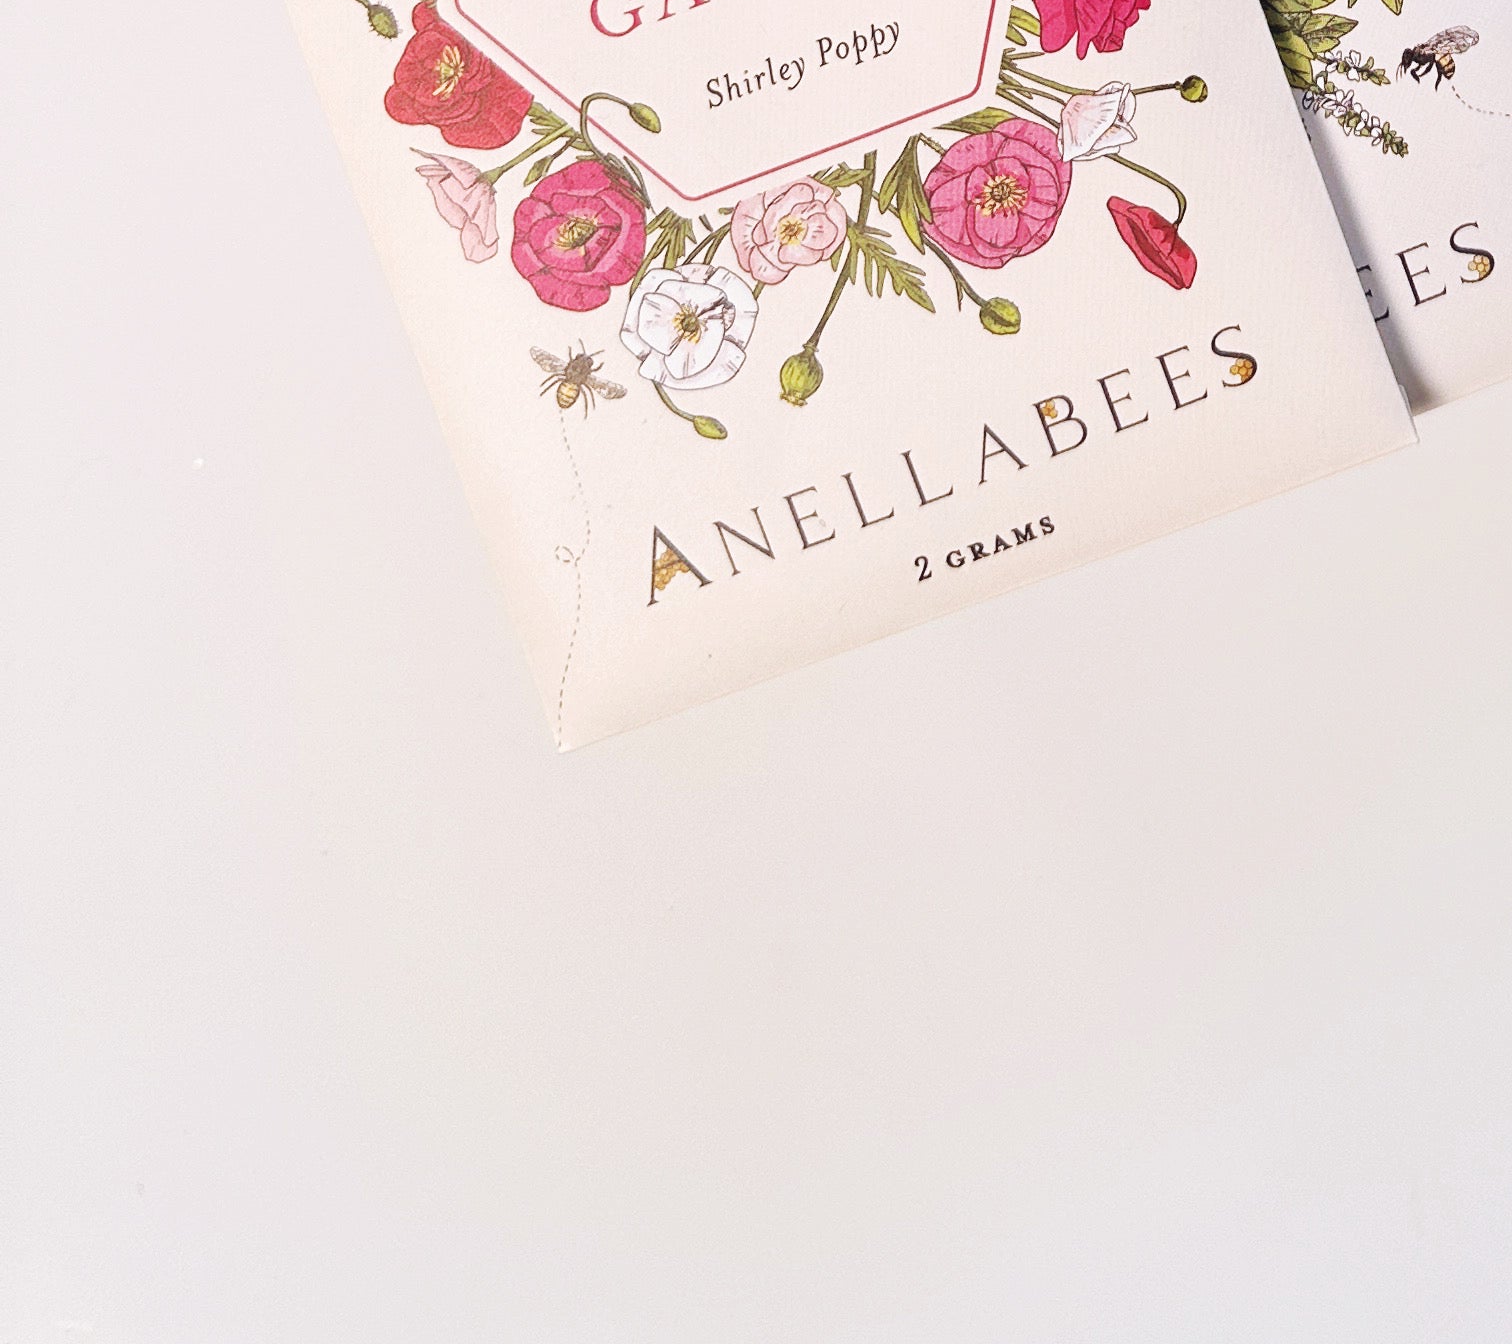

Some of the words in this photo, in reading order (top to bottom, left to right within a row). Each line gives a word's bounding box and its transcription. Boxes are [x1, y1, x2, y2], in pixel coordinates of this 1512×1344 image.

[705, 54, 807, 110] Shirley
[815, 17, 902, 70] Poppy
[644, 323, 1261, 608] ANELLABEES
[913, 553, 933, 582] 2
[944, 513, 1058, 571] GRAMS
